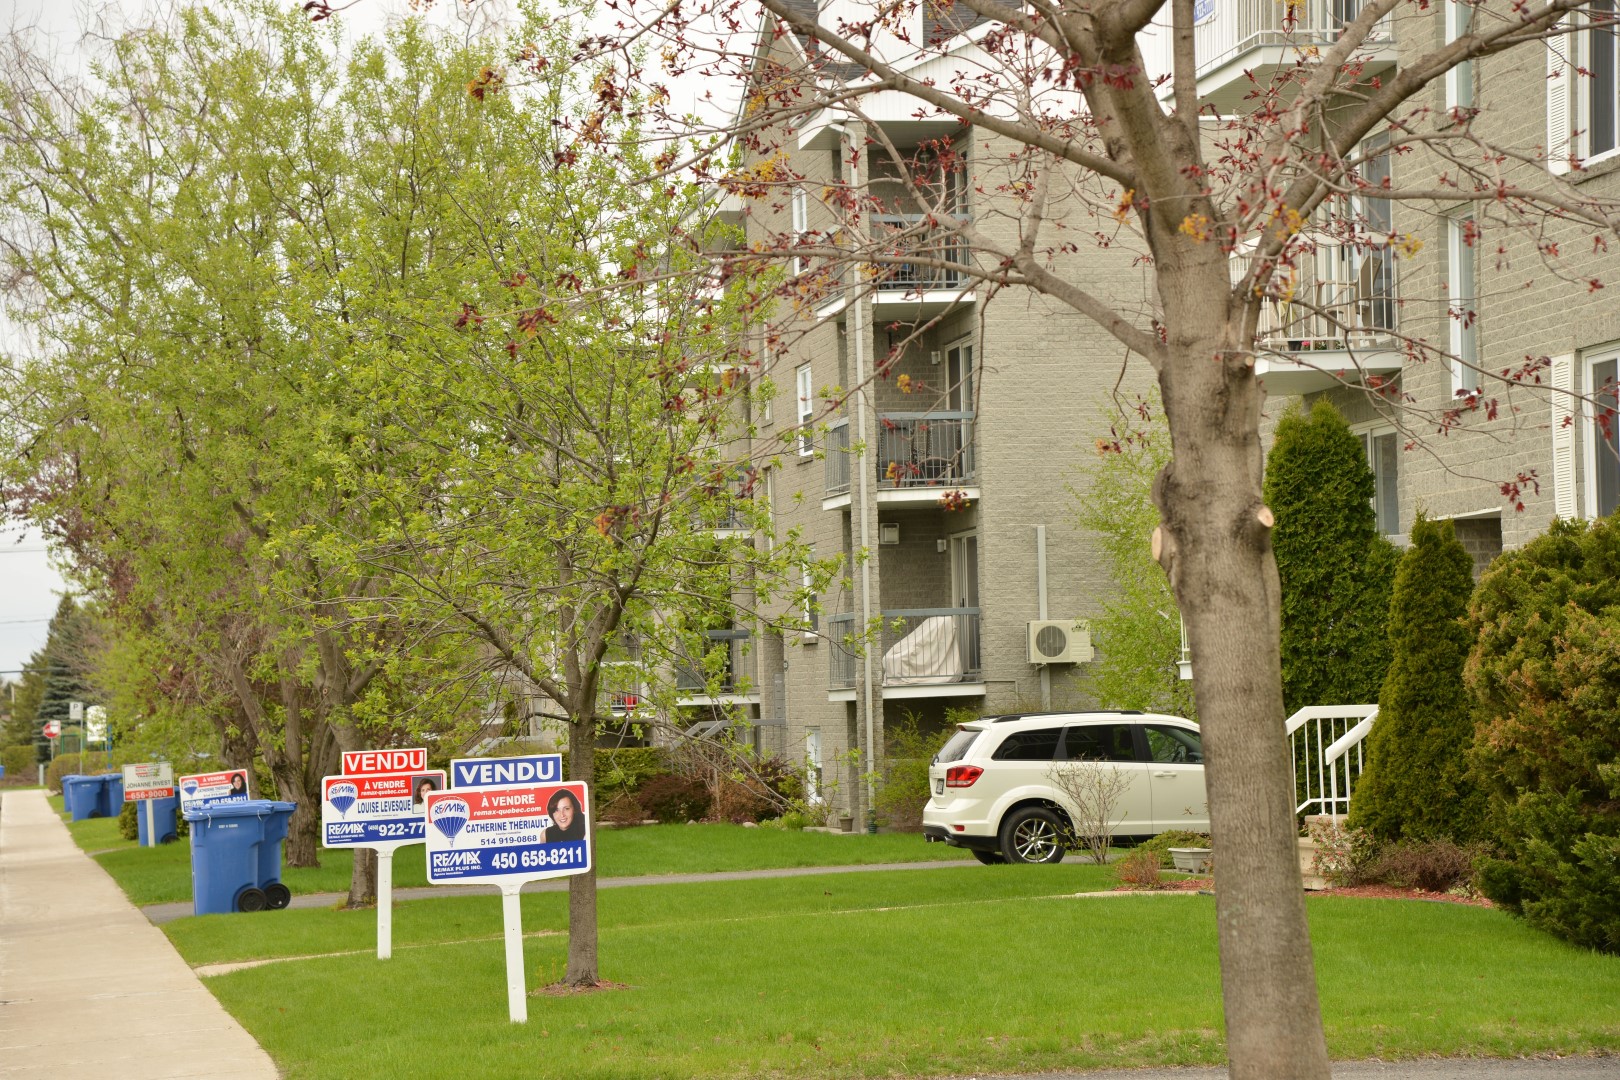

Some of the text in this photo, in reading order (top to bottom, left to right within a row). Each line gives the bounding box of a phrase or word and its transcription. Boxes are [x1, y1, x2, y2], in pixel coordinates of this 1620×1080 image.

[346, 751, 424, 772] VENDU
[459, 760, 554, 784] VENDU
[152, 779, 171, 787] RIVEST
[331, 784, 355, 794] RE/MAX
[364, 780, 406, 790] À VENDRE
[130, 789, 168, 799] 656-9000
[360, 788, 409, 796] remax-quebec.com
[357, 799, 411, 814] LOUISE LEVESQUE
[481, 793, 536, 808] À VENDRE
[434, 803, 466, 814] RE/MAX
[473, 805, 542, 817] remax-quebec.com
[328, 822, 365, 835] RE/MAX
[465, 818, 549, 834] CATHERINE THÉRIAULT
[480, 834, 537, 846] 514 919-0868
[433, 850, 481, 867] RE/MAX
[491, 846, 583, 869] 450 658-8211
